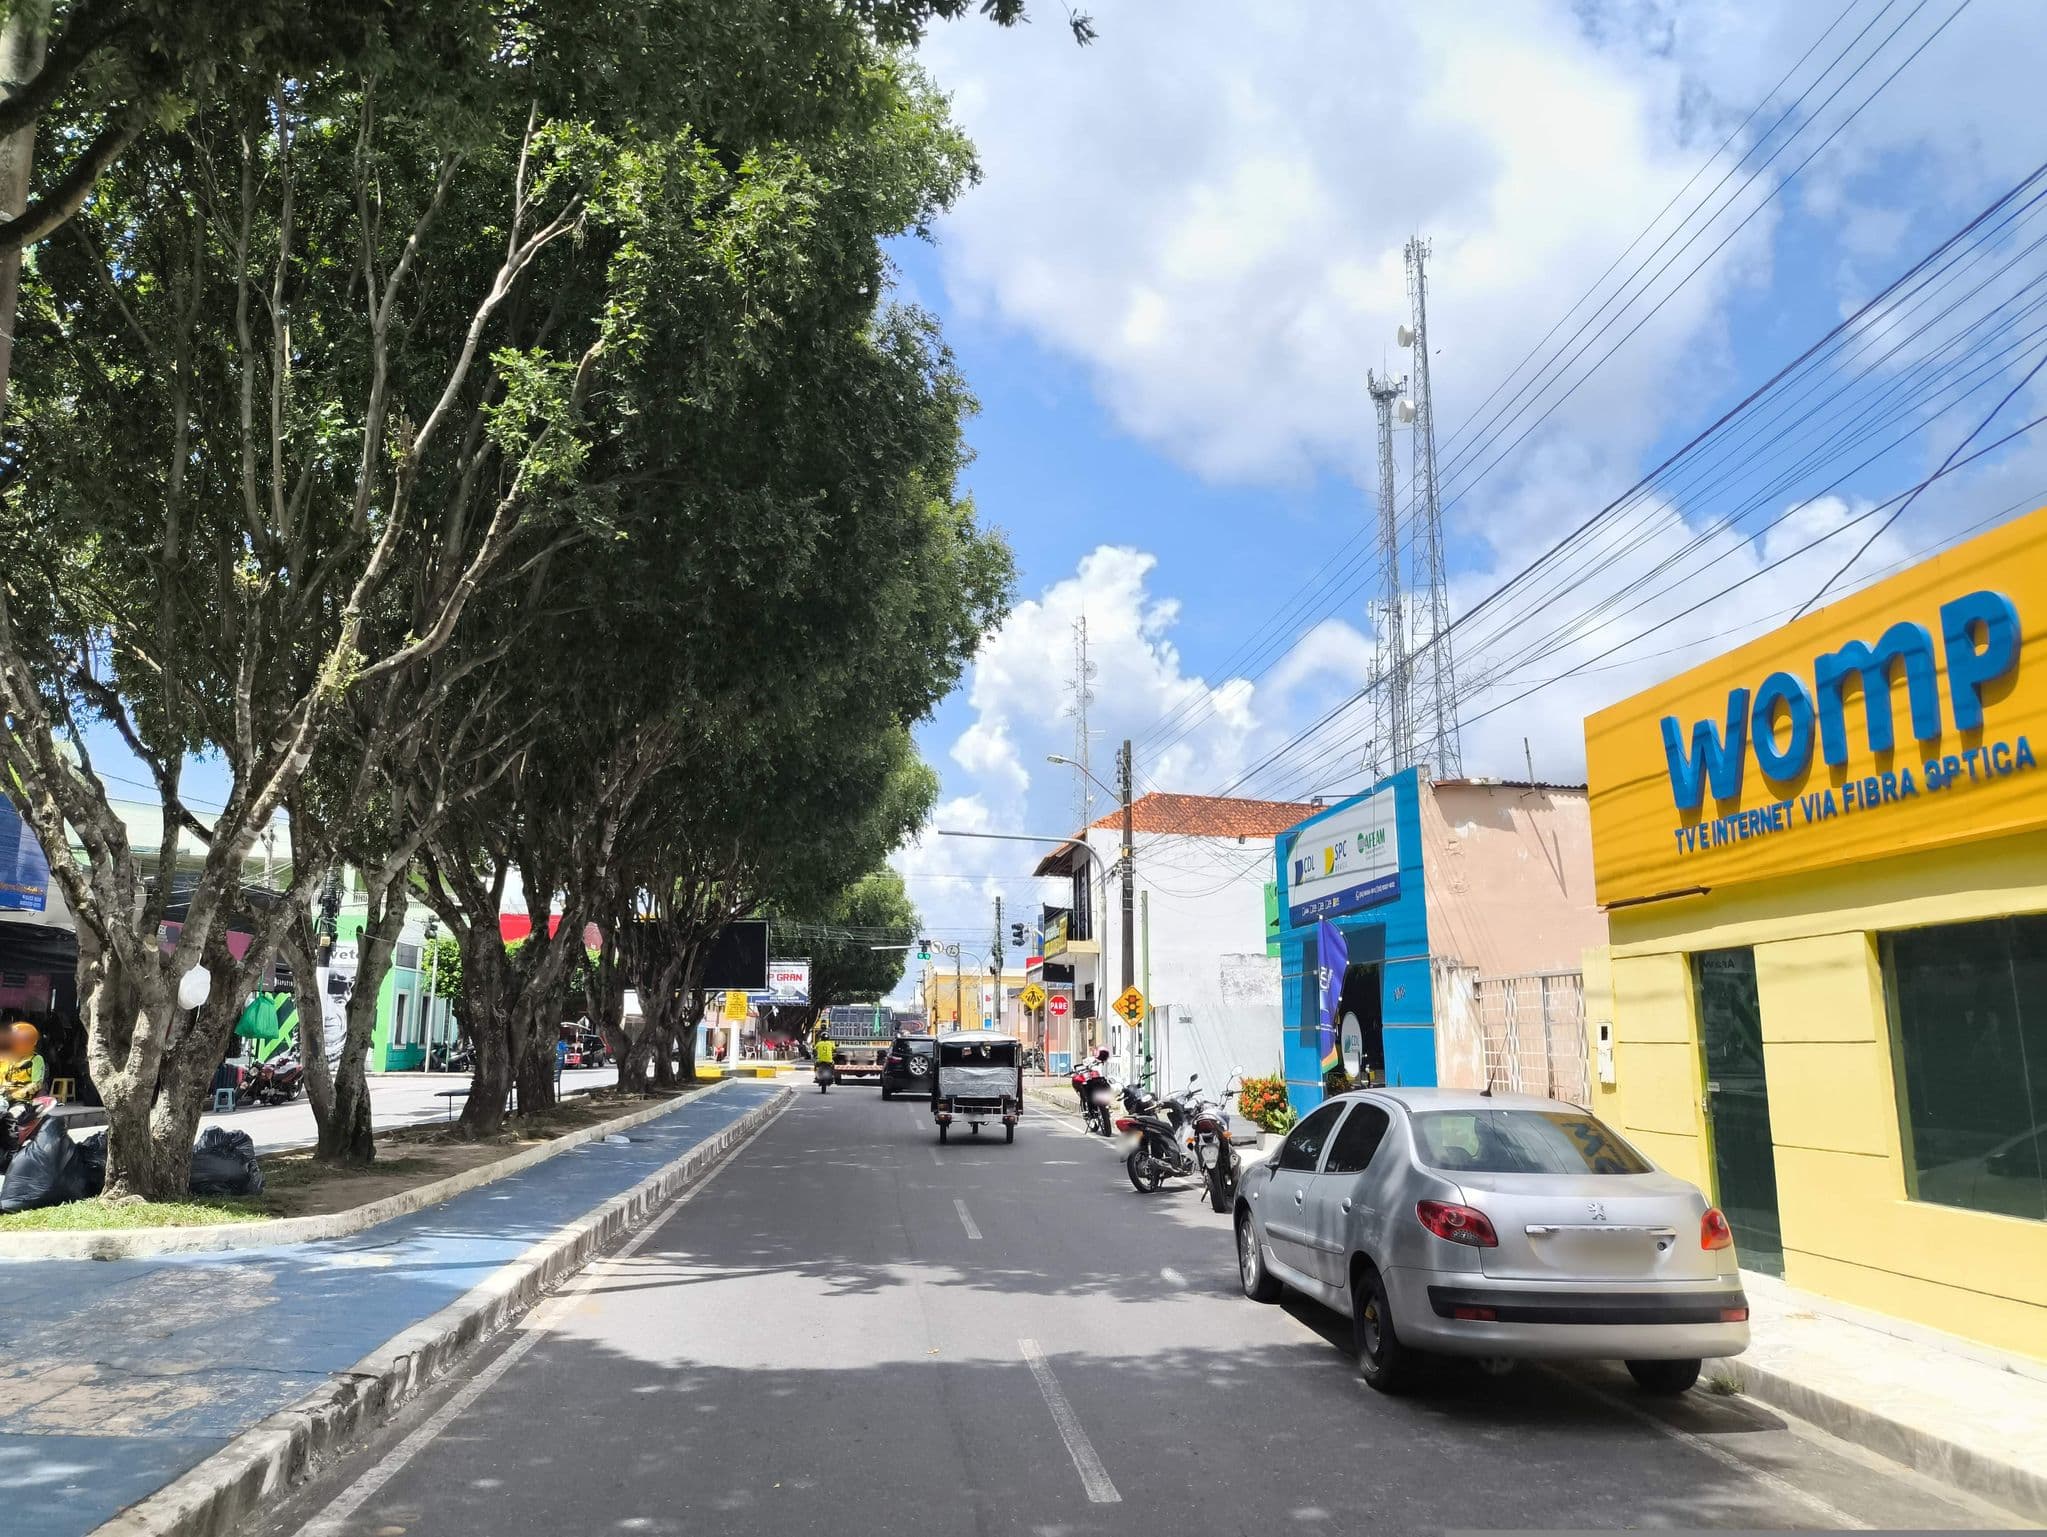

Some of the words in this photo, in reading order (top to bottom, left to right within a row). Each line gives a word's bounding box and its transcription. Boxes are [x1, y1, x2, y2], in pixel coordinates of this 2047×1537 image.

[1712, 799, 1794, 847] INTERNET
[1800, 789, 1838, 824] VIA
[1842, 768, 1919, 814] FIBRA
[1364, 827, 1386, 850] AFEAM
[1334, 839, 1347, 861] SPC
[1303, 854, 1315, 874] CDL
[776, 973, 803, 982] GRAN
[1050, 1002, 1068, 1010] PARE
